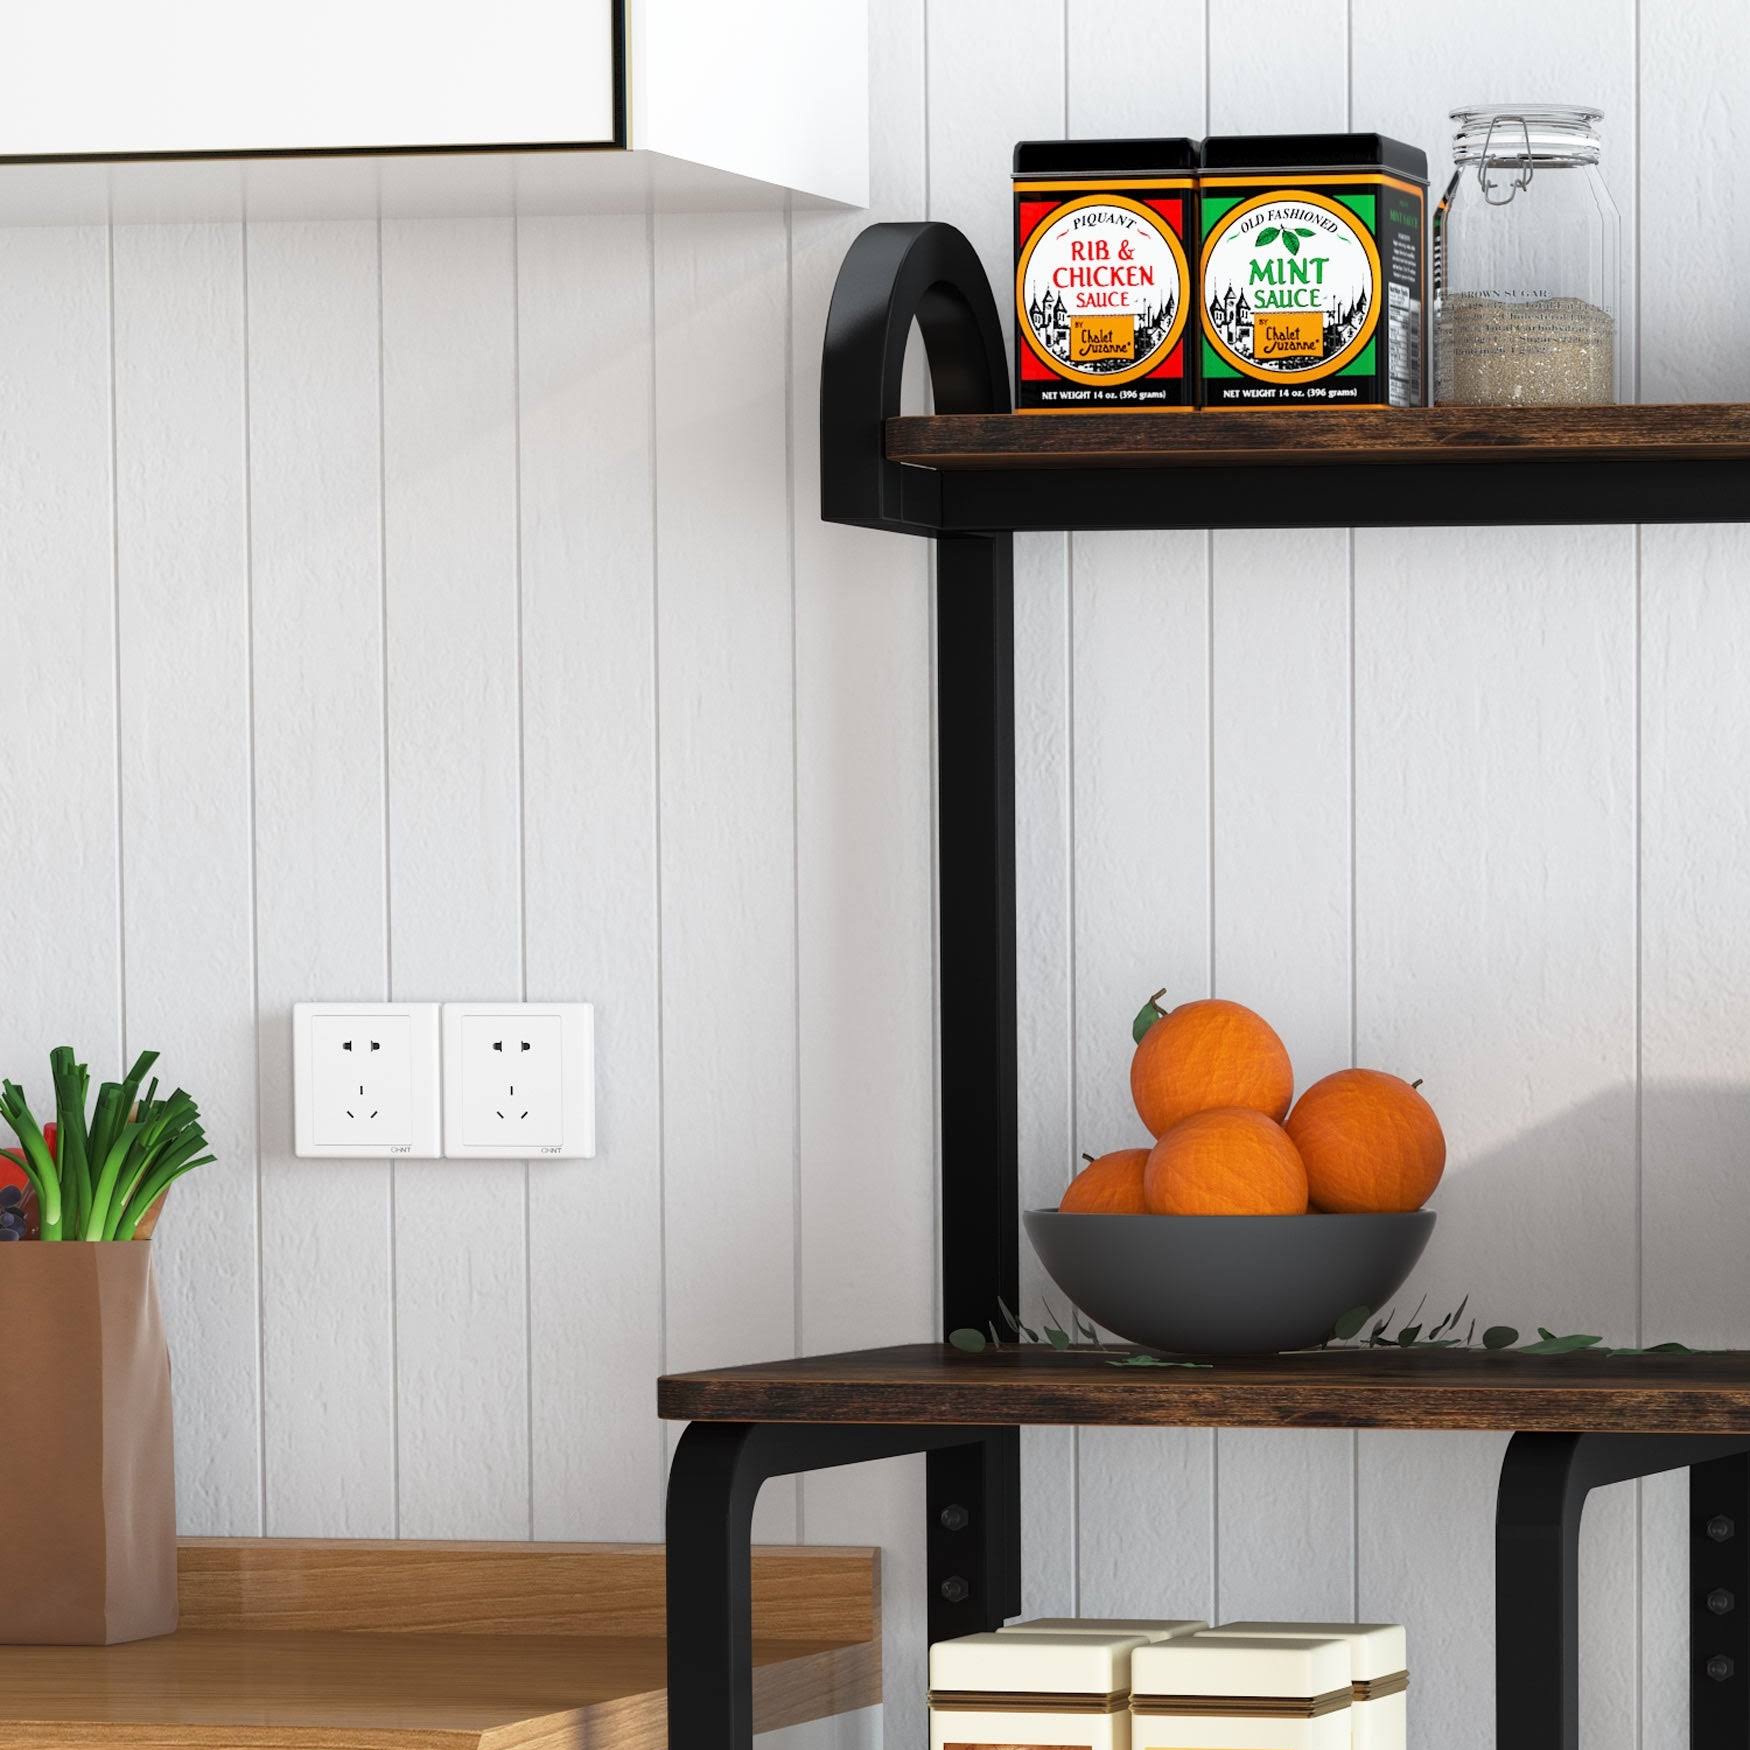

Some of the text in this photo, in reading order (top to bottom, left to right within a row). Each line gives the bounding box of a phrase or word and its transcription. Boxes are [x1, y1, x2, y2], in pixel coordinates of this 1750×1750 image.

[1073, 212, 1137, 230] PIQUANT
[1240, 208, 1338, 233] OLD FASHIONED
[1071, 240, 1135, 261] RIB &
[1052, 265, 1154, 288] CHICKEN
[1249, 258, 1330, 286] MINT
[1076, 291, 1130, 308] SAUCE
[1254, 288, 1322, 309] SAUCE
[1081, 329, 1113, 344] Chalet
[1266, 326, 1300, 341] Chalet
[1042, 391, 1058, 400] NET
[1059, 391, 1091, 400] WEIGHT
[1093, 390, 1103, 399] 14
[1119, 390, 1137, 399] (396
[1139, 390, 1166, 400] grams)
[1223, 388, 1357, 399] NET WEIGHT 14 oz. (396 grams)
